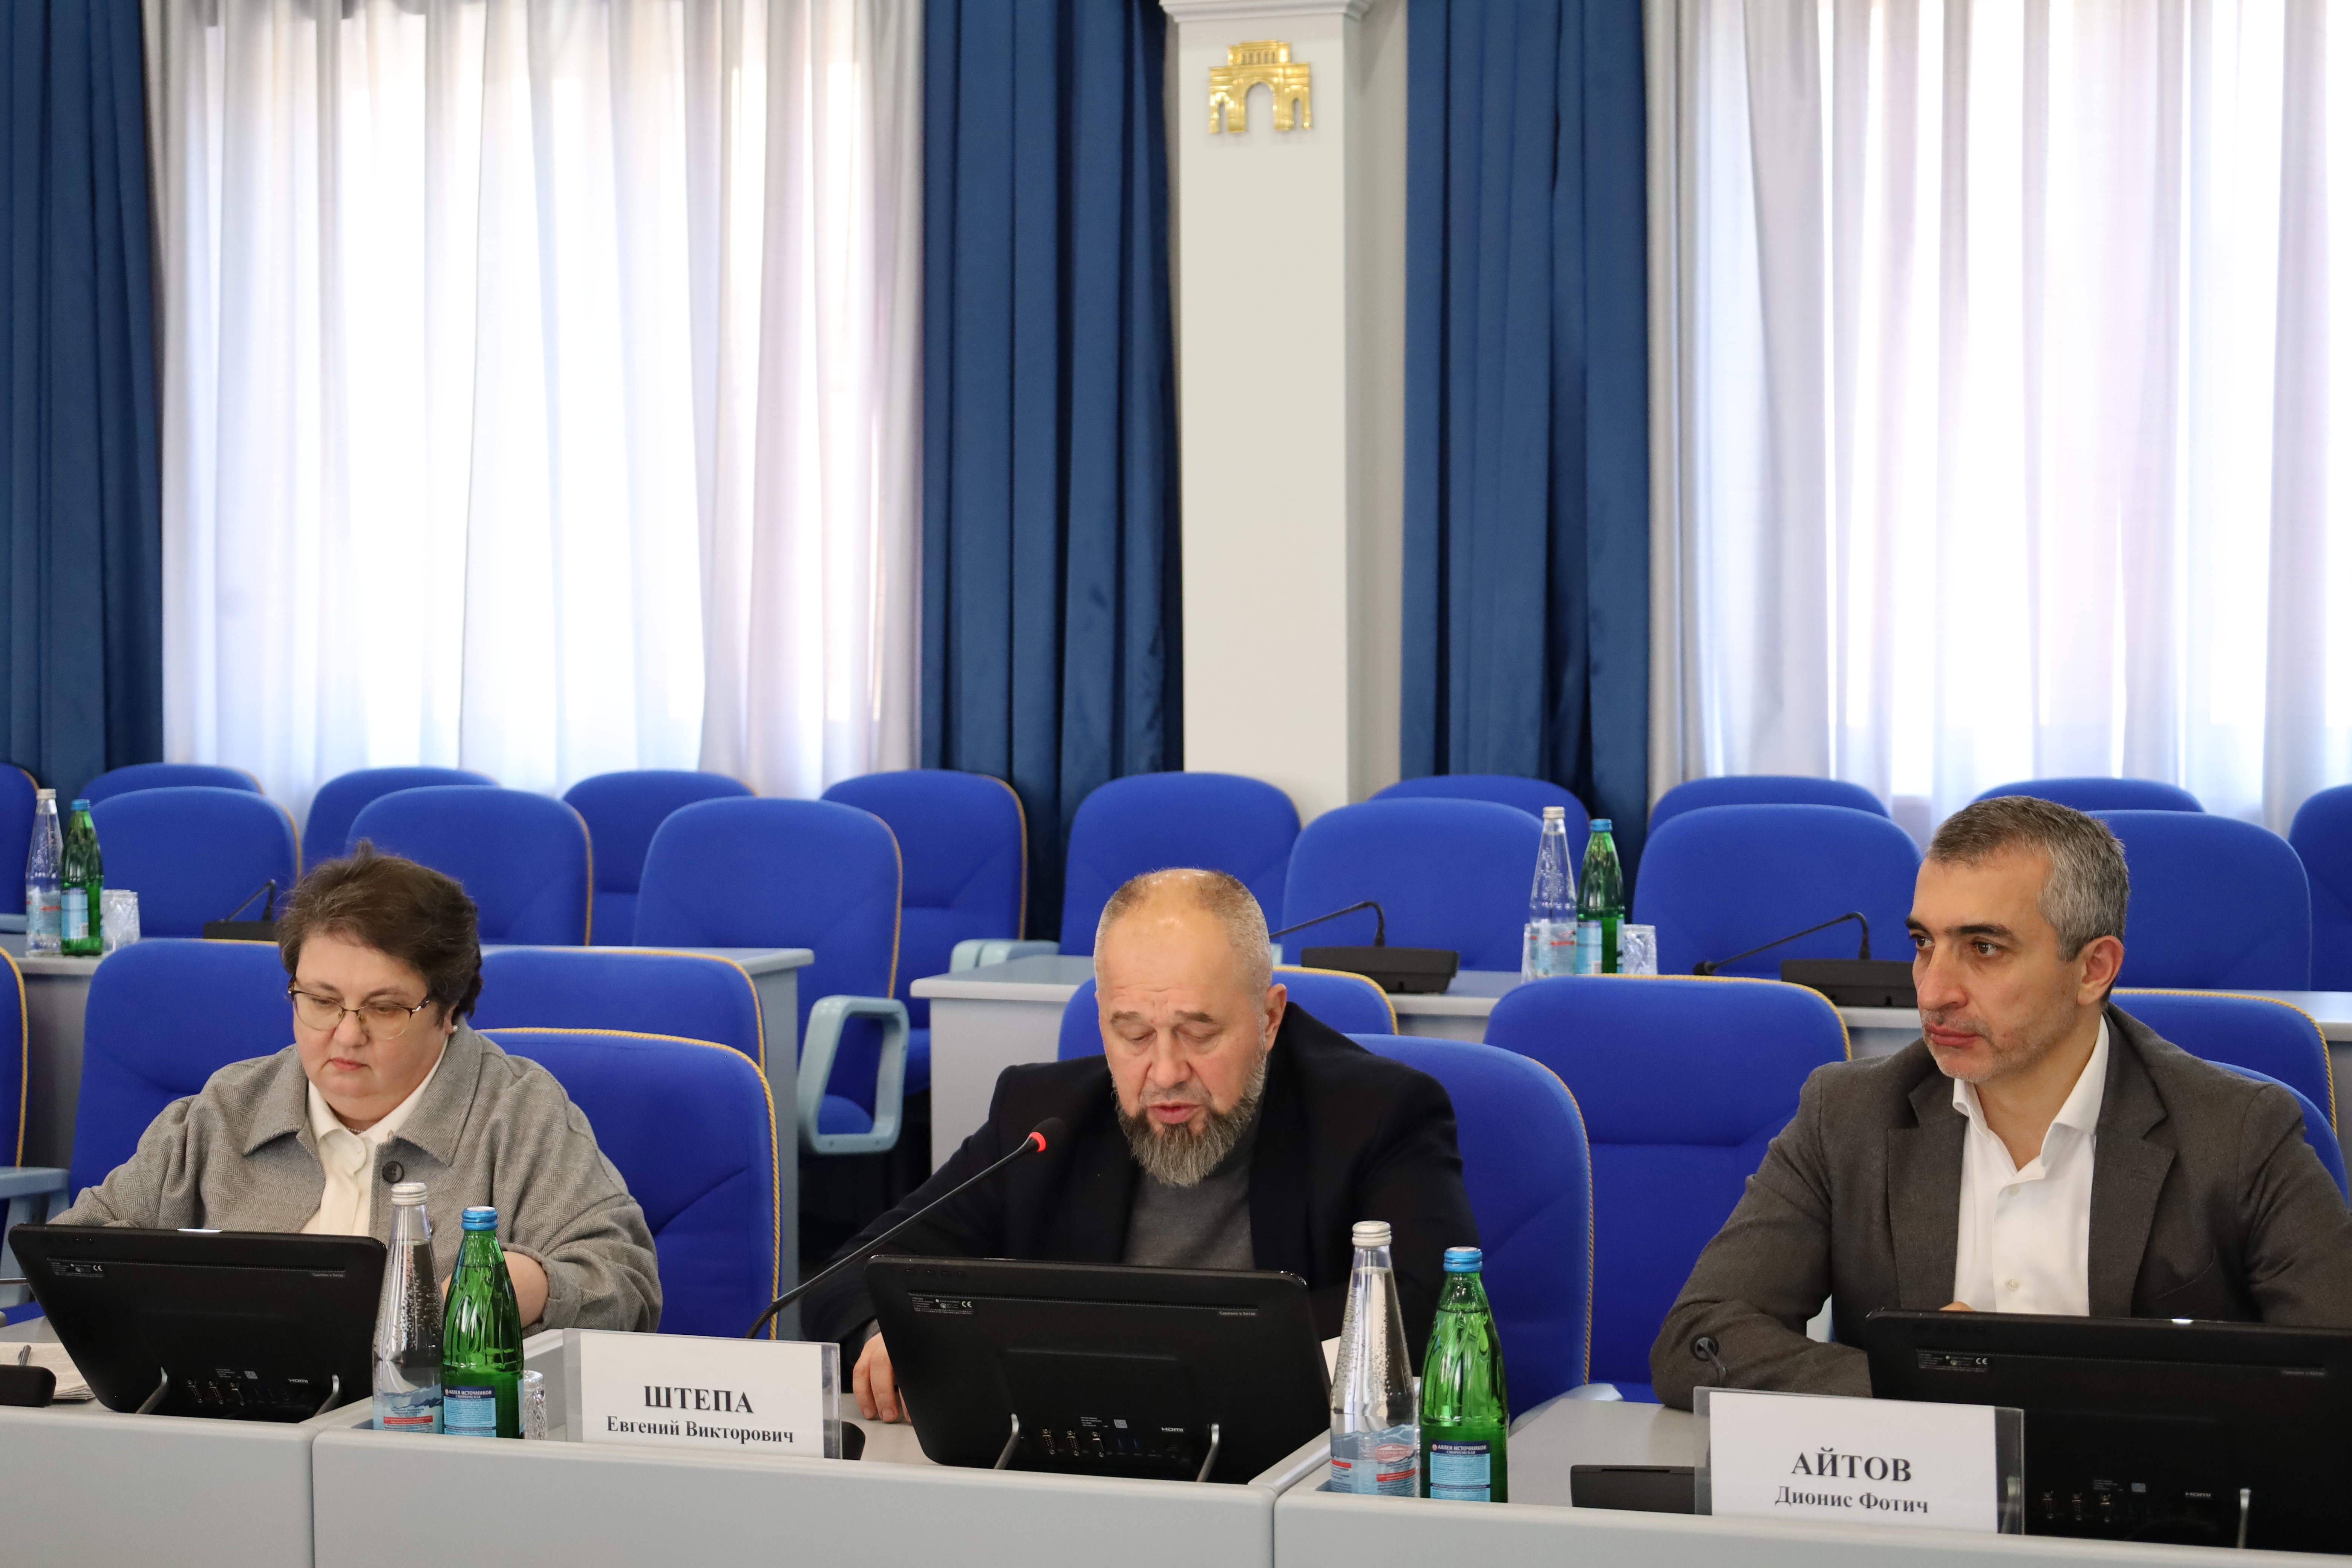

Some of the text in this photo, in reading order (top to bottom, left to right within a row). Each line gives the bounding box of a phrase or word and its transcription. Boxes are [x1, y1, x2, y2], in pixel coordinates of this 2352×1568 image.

[643, 1385, 755, 1413] ШТЕПА
[606, 1416, 794, 1444] Евгений Викторович
[1791, 1447, 1911, 1481] АЙТОВ
[1775, 1486, 1928, 1513] Дионис Фотич
